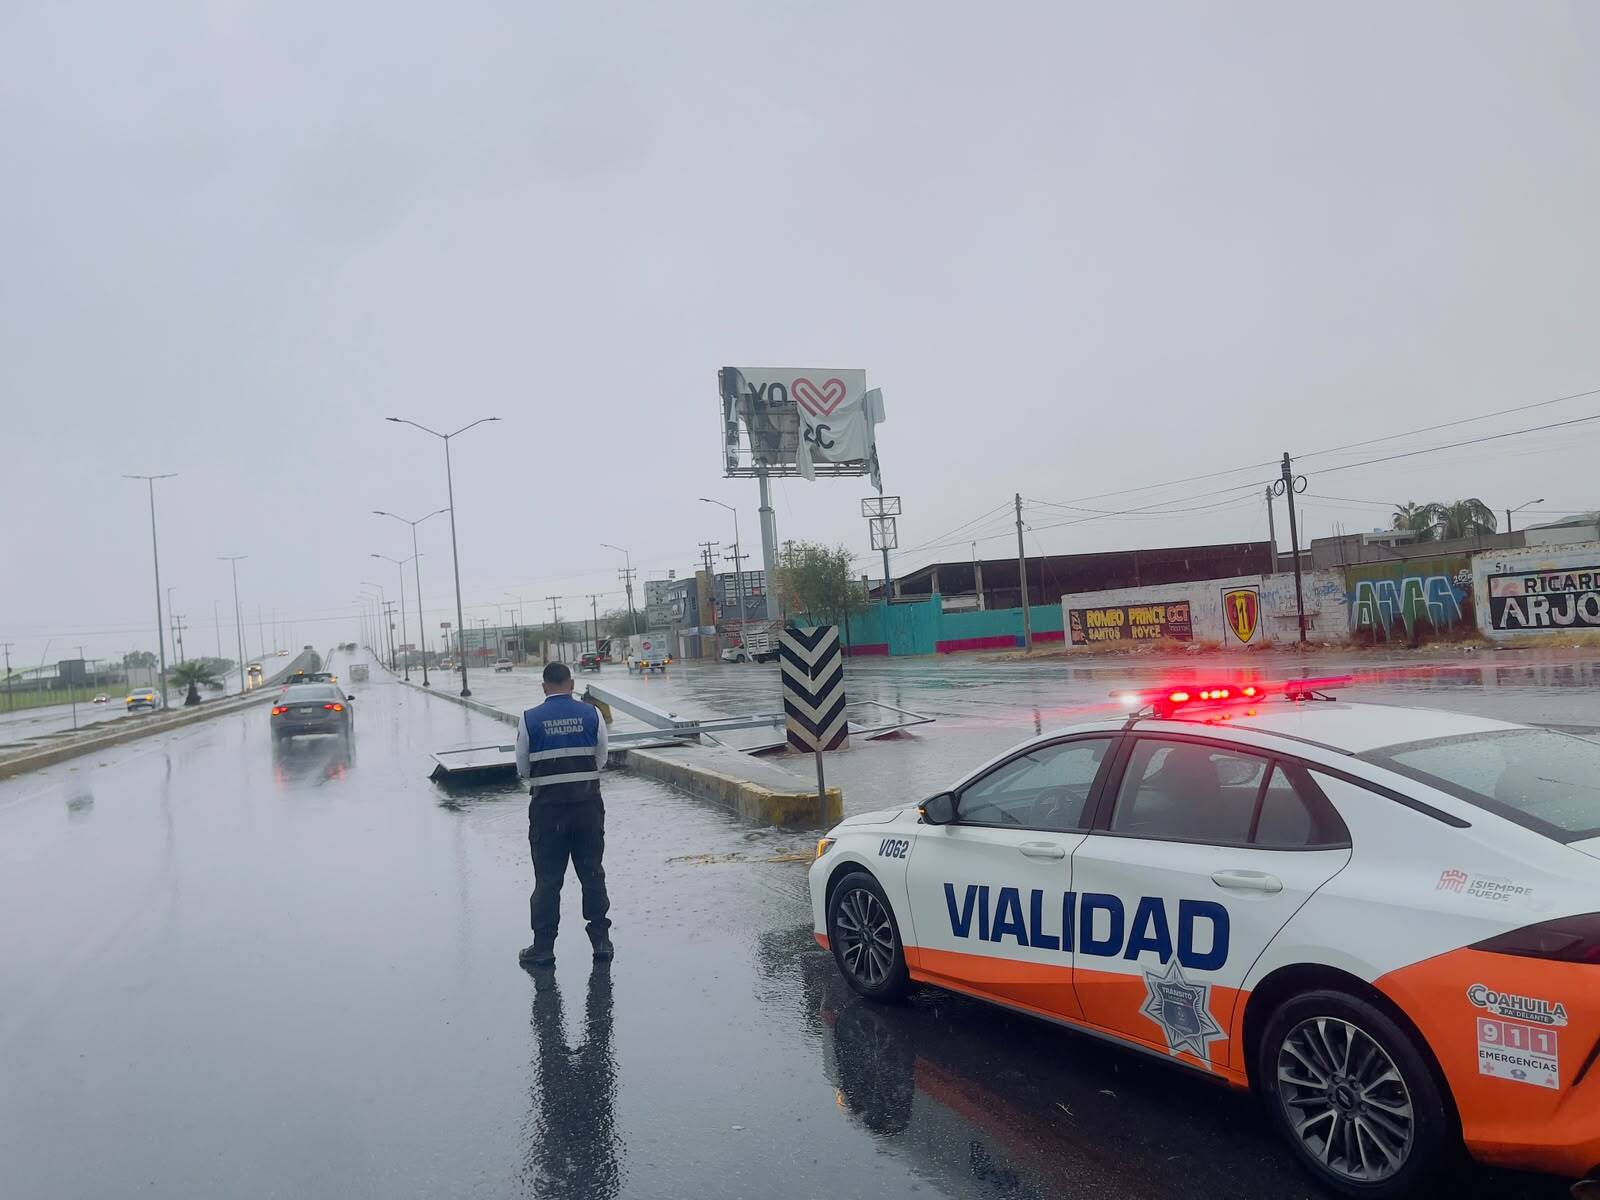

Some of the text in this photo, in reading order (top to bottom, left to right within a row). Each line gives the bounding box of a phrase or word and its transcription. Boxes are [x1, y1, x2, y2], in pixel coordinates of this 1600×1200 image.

[1086, 609, 1124, 628] ROMEO
[1128, 606, 1166, 626] PRINCE
[1088, 627, 1121, 641] SANTOS
[1131, 624, 1161, 639] ROYCE
[544, 725, 584, 736] VIALIDAD
[944, 883, 1231, 972] VIALIDAD
[1467, 984, 1568, 1018] COAHUILA
[1516, 1011, 1550, 1023] DELANTE
[1483, 1024, 1550, 1053] 911
[1479, 1050, 1557, 1073] EMERGENCIAS
